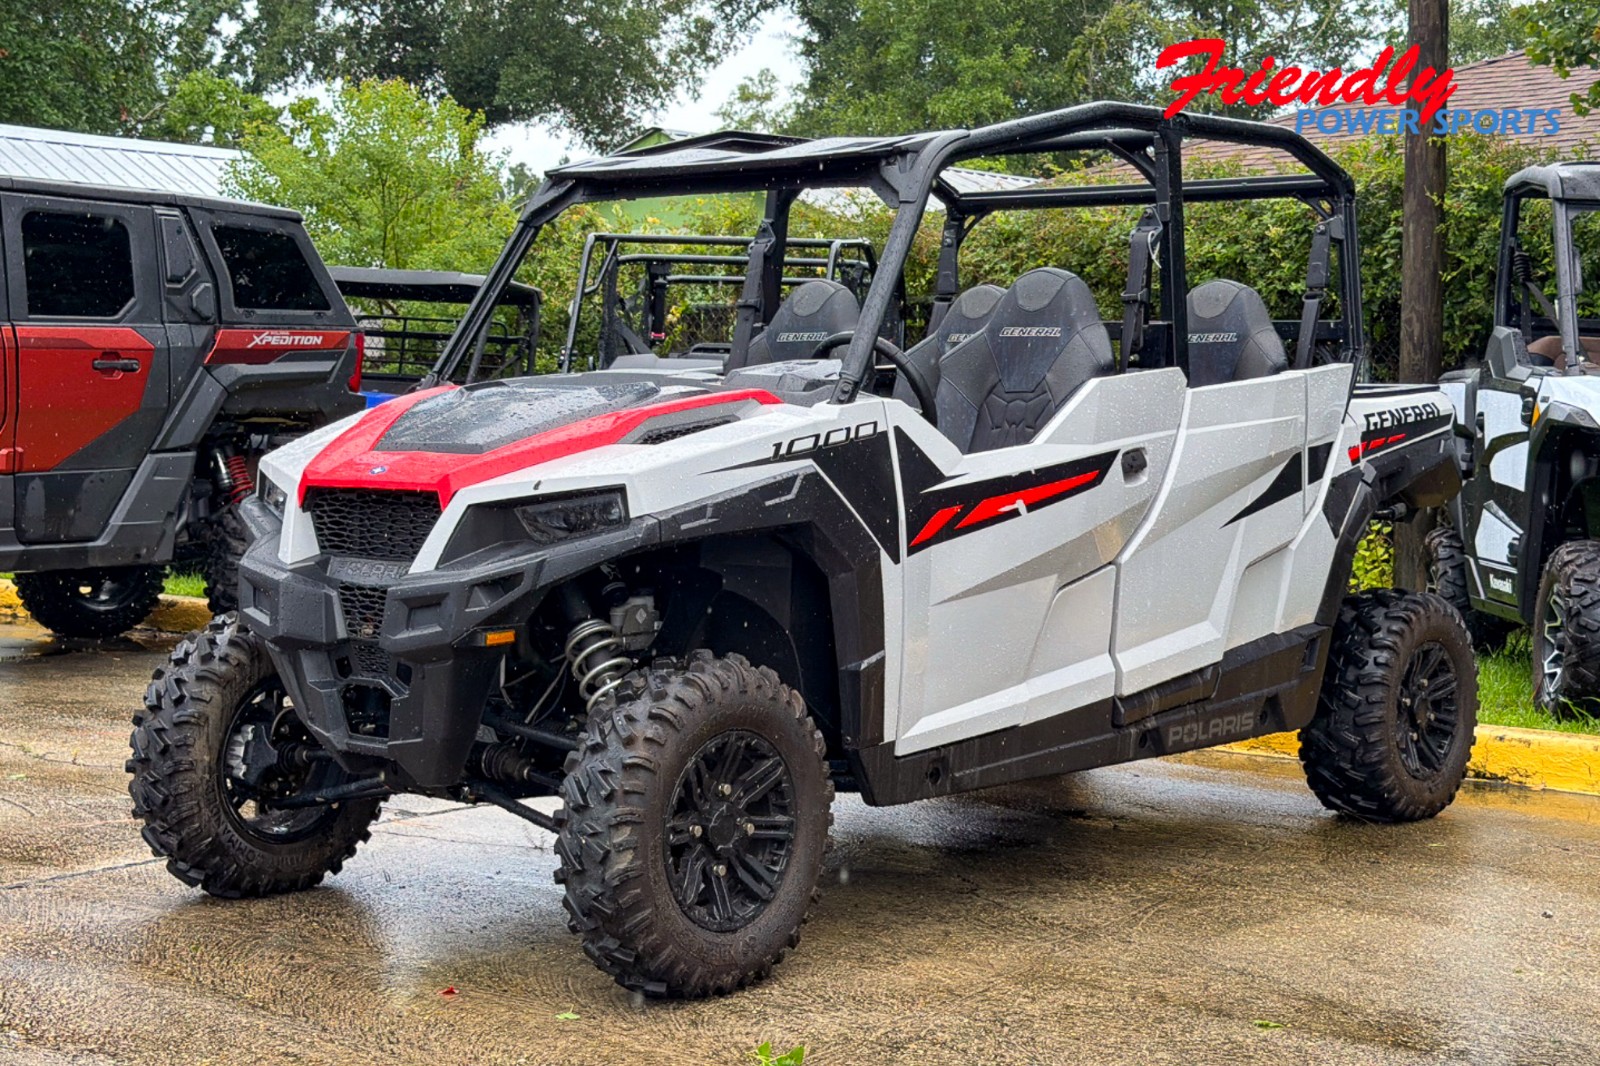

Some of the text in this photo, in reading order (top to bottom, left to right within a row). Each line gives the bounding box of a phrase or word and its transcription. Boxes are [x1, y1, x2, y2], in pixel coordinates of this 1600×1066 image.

[246, 331, 323, 348] XPEDITION
[999, 326, 1061, 337] GENERAL
[1187, 332, 1238, 344] ENERAL
[1363, 402, 1440, 431] GENERAL
[771, 420, 878, 460] 1000
[1168, 712, 1254, 747] POLARIS
